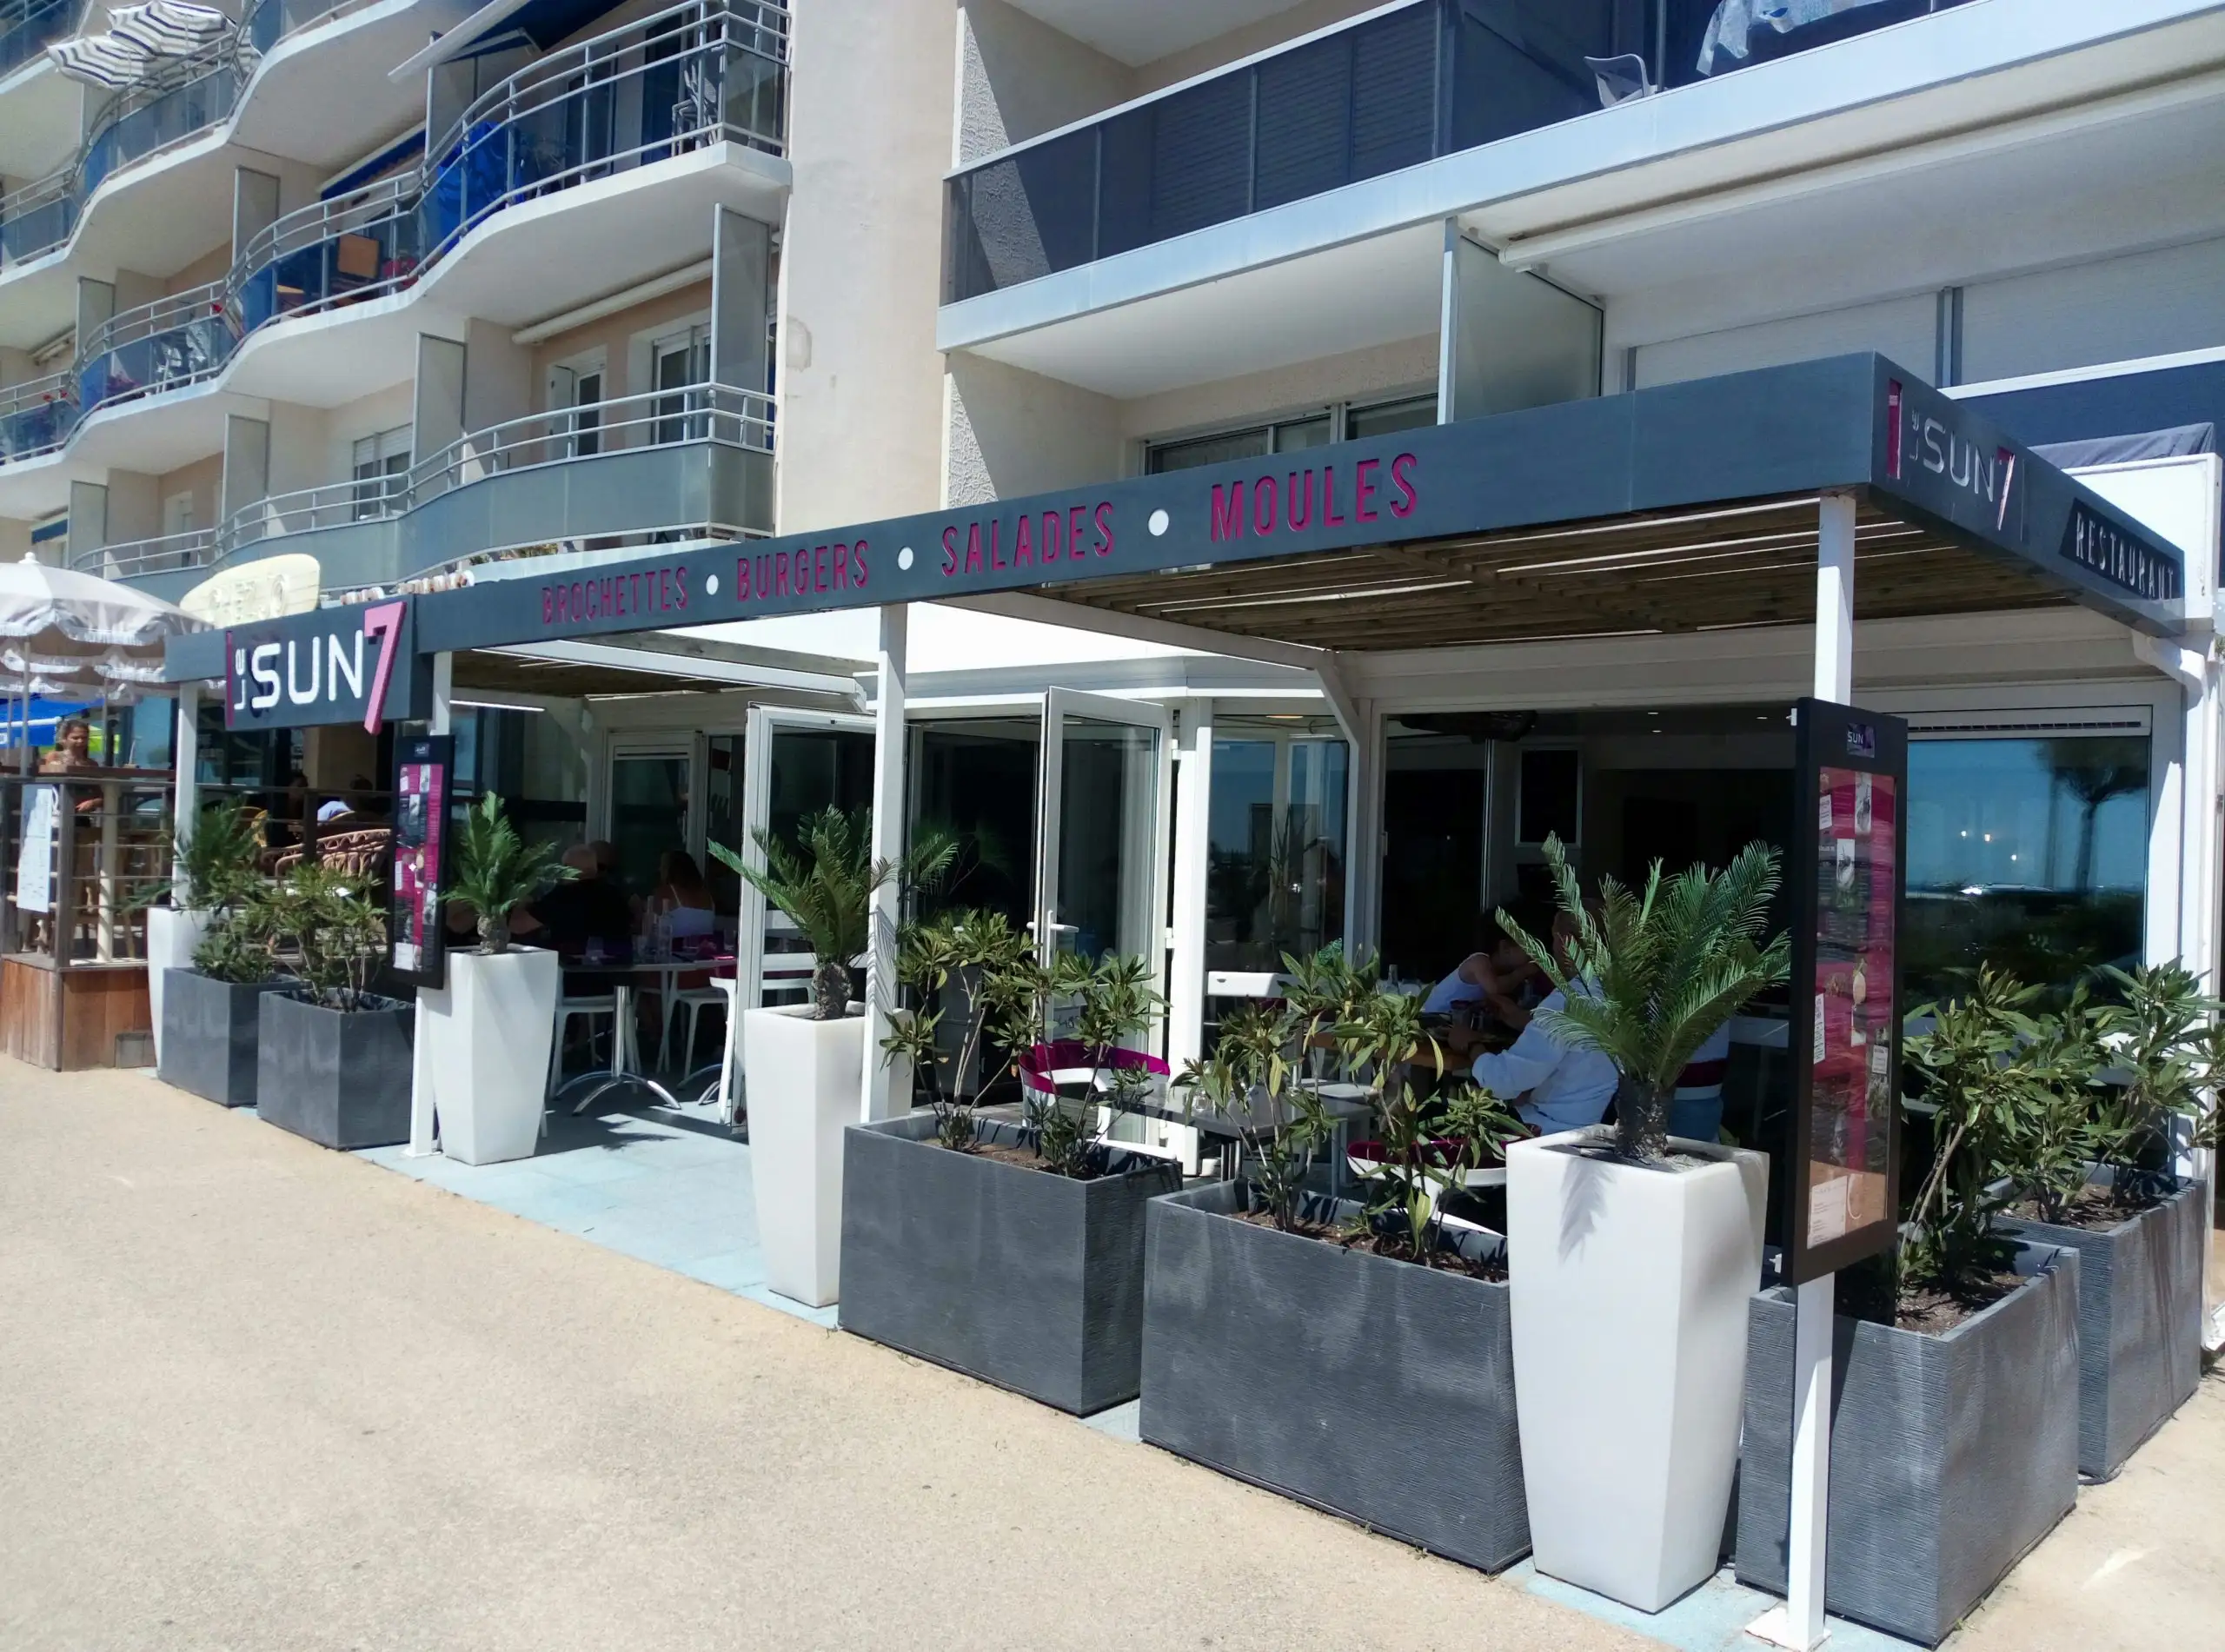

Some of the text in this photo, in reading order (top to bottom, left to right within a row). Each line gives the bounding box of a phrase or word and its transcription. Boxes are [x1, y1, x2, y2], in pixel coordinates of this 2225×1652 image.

[541, 453, 1418, 625] BROCHETTES BURGERS SALADES MOULES
[2076, 511, 2175, 600] RESTAURANT
